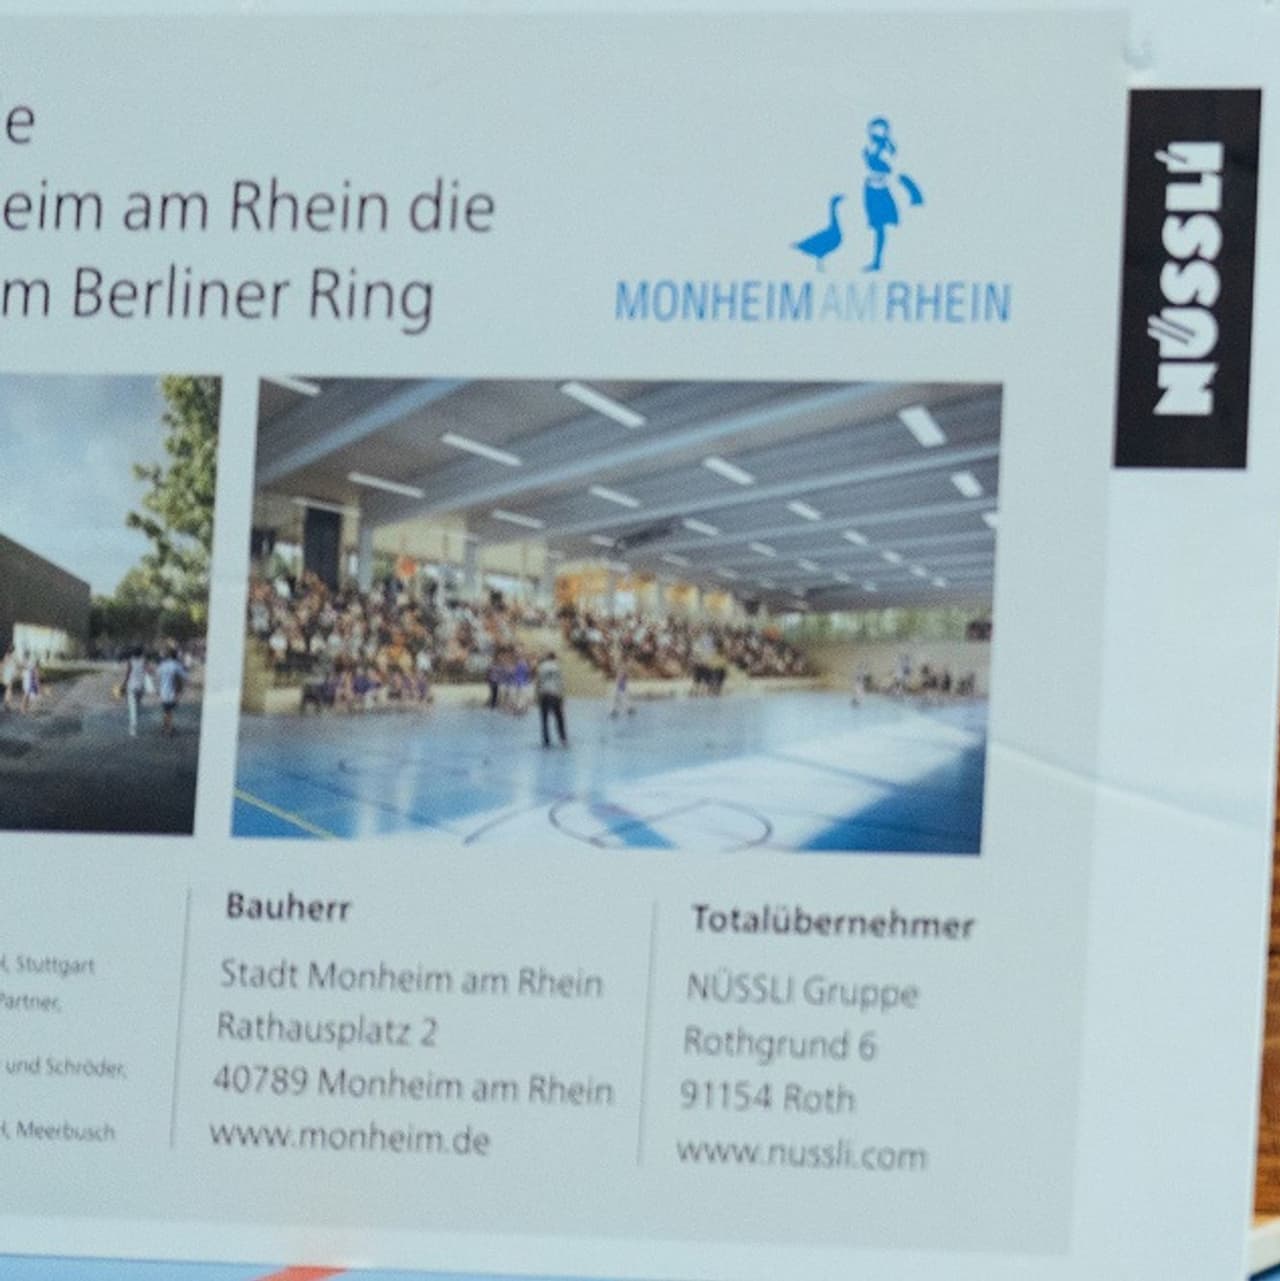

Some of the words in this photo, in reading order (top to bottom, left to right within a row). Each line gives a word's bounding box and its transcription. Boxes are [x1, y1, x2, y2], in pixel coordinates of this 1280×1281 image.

[2, 179, 103, 232] eim
[122, 191, 209, 232] am
[230, 176, 389, 233] Rhein
[408, 176, 496, 234] die
[72, 262, 291, 320] Berliner
[309, 266, 434, 337] Ring
[225, 890, 352, 923] Bauherr
[691, 903, 976, 941] Totalübernehmer
[15, 954, 96, 980] Stuttgart
[220, 957, 299, 990] Stadt
[307, 960, 454, 994] Monheim
[460, 971, 510, 996] am
[517, 965, 604, 999] Rhein
[686, 967, 795, 1006] NÜSSLI
[802, 973, 921, 1014] Gruppe
[216, 1010, 412, 1051] Rathausplatz
[419, 1016, 439, 1048] 2
[683, 1024, 851, 1067] Rothgrund
[857, 1029, 879, 1063] 6
[4, 1055, 42, 1077] und
[212, 1063, 310, 1097] 40789
[317, 1066, 464, 1101] Monheim
[471, 1078, 520, 1103] am
[527, 1073, 615, 1107] Rhein
[680, 1078, 773, 1112] 91154
[783, 1081, 857, 1115] Roth
[15, 1119, 116, 1143] Meerbusch
[208, 1120, 492, 1157] www.monheim.de
[675, 1138, 928, 1172] www.nussli.com
